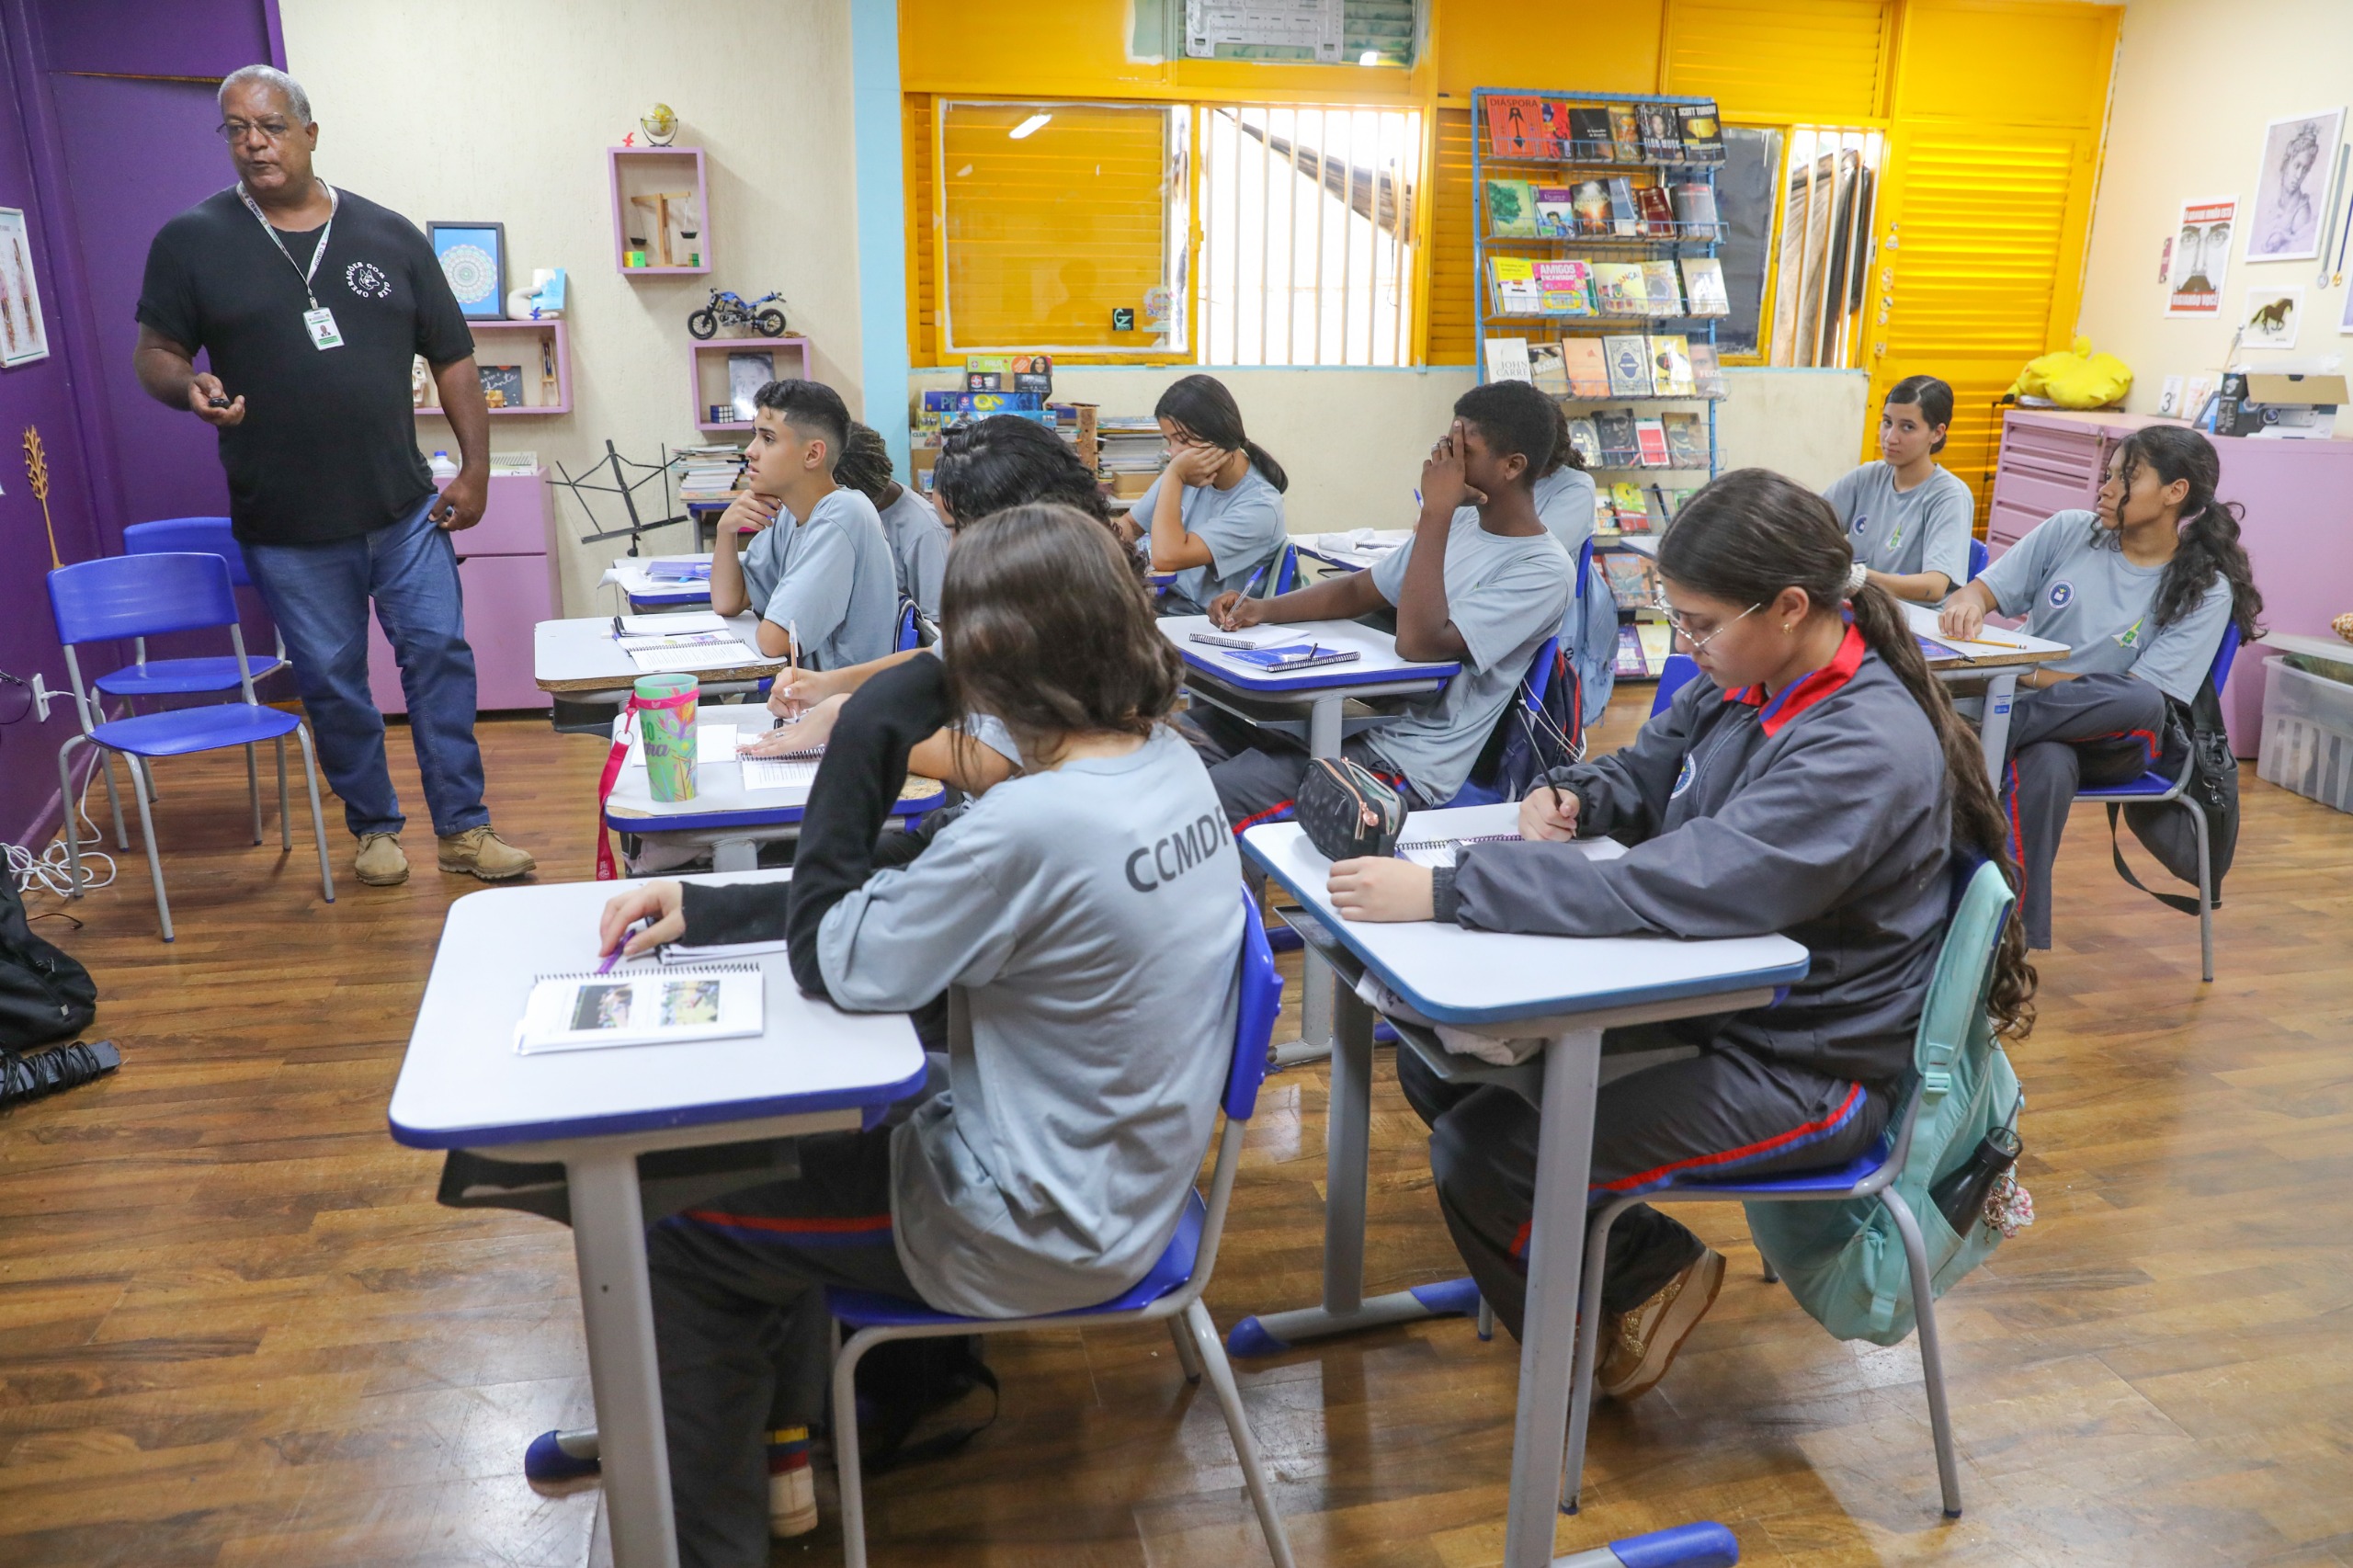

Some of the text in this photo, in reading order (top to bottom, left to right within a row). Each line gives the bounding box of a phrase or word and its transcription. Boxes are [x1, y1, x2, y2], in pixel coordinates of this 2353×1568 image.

[1490, 97, 1538, 108] DIÁSPORA
[1678, 107, 1696, 117] SCOTT
[1661, 138, 1680, 149] MUSK
[366, 263, 385, 279] COM
[1540, 264, 1575, 275] AMIGOS
[1501, 360, 1528, 369] JOHN
